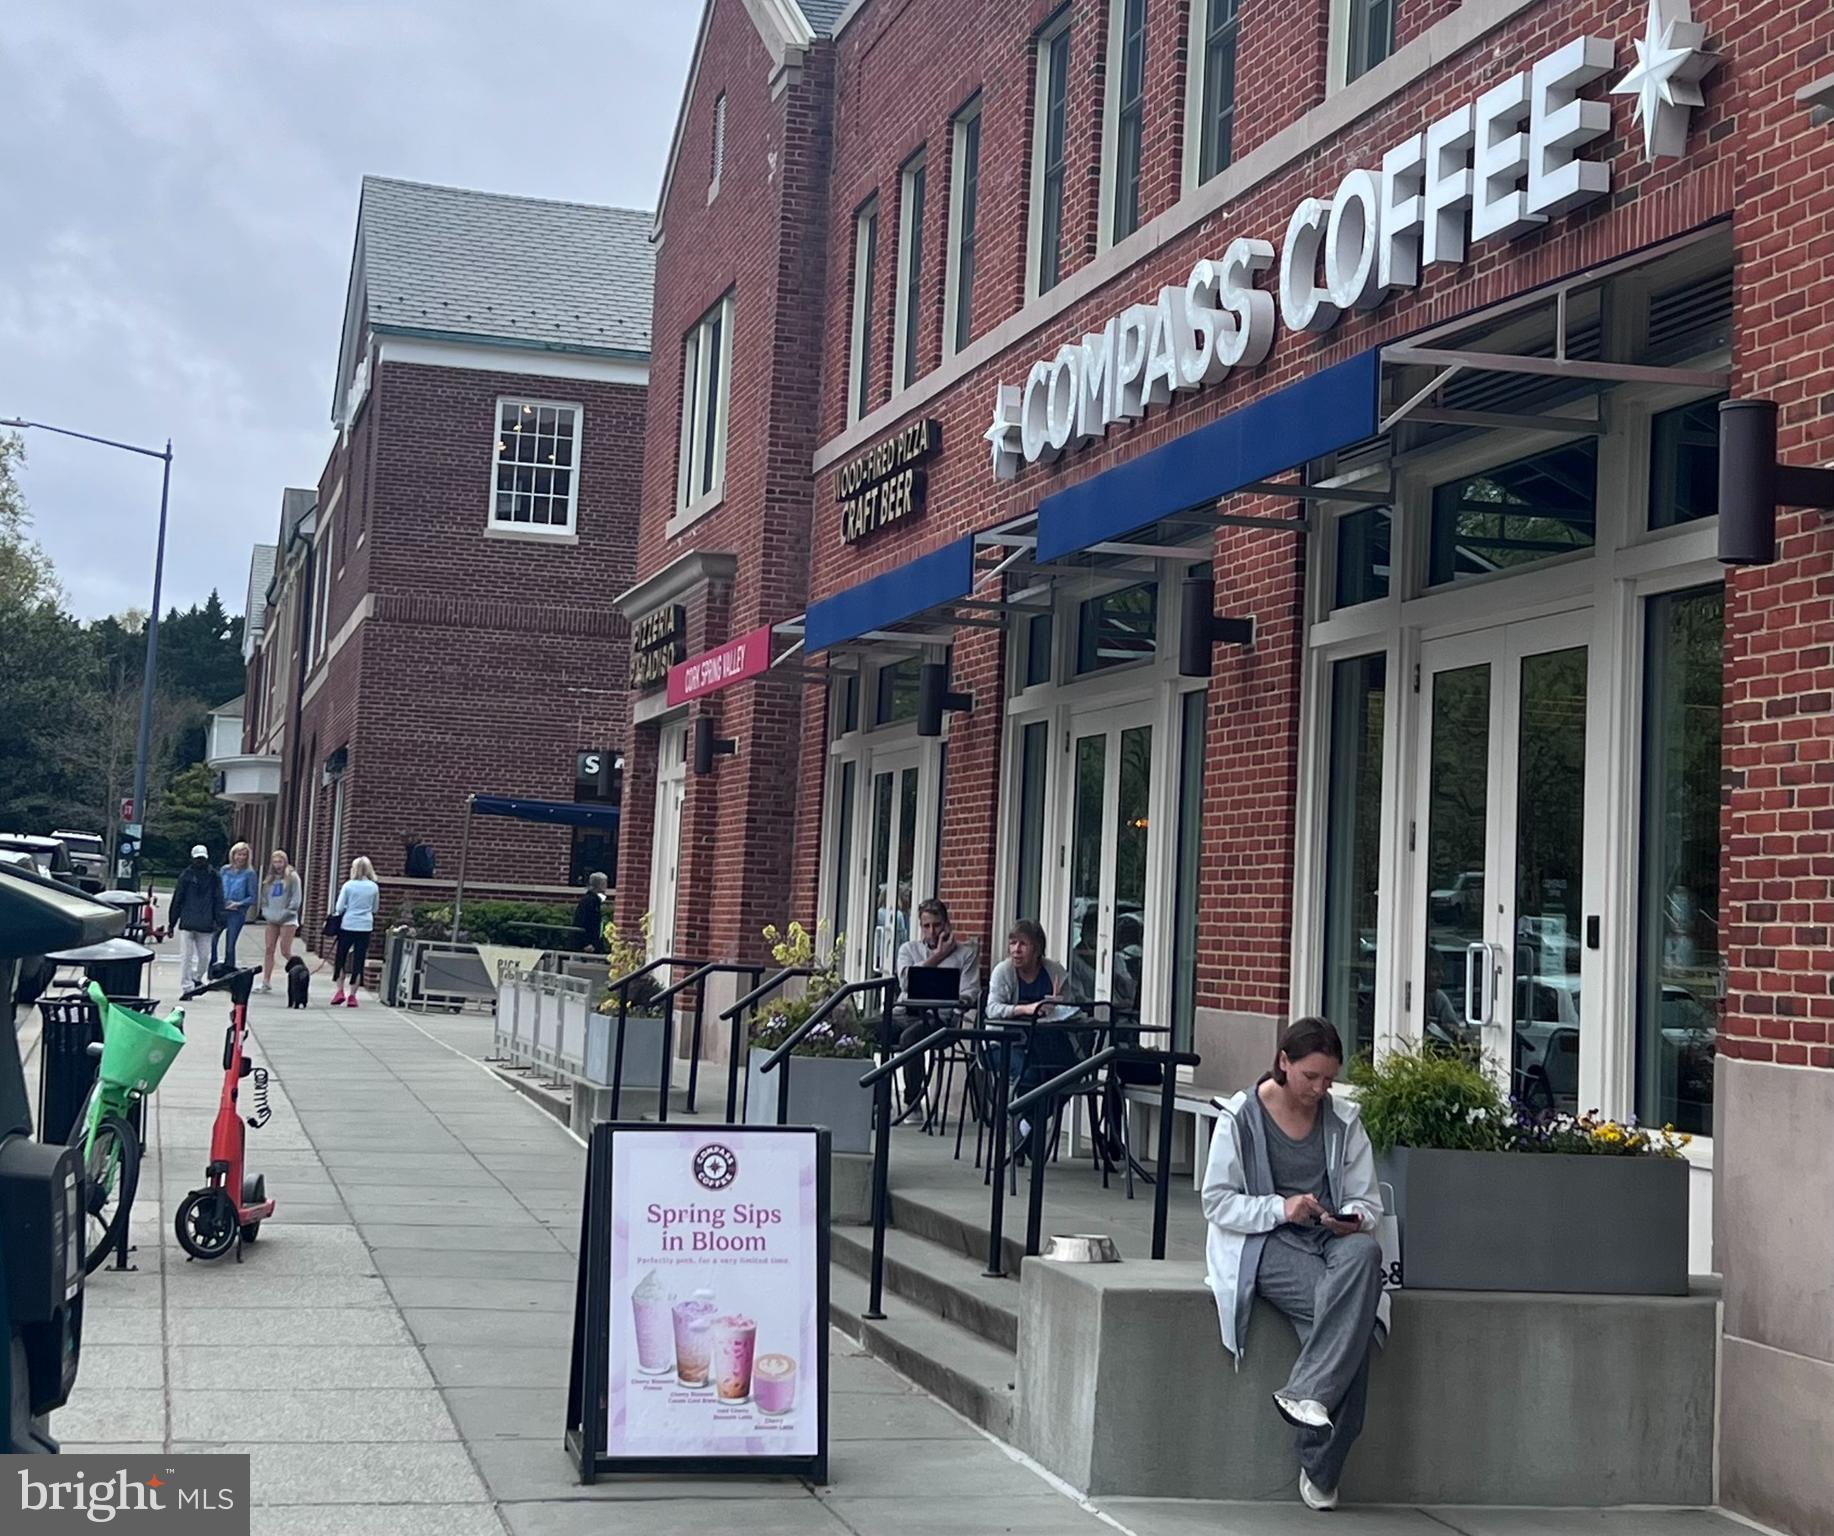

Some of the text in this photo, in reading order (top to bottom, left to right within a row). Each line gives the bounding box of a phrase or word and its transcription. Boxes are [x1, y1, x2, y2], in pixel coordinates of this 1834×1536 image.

[1021, 35, 1614, 463] COMPASS COFFEE
[896, 419, 929, 466] PIZZA
[840, 468, 913, 545] CRAFT BEER
[701, 654, 722, 687] SPRING
[722, 644, 747, 679] VALLEY
[697, 1146, 734, 1165] COMPASS
[698, 1172, 733, 1188] COFFEE
[647, 1203, 782, 1229] Spring Sips
[662, 1231, 766, 1251] in Bloom
